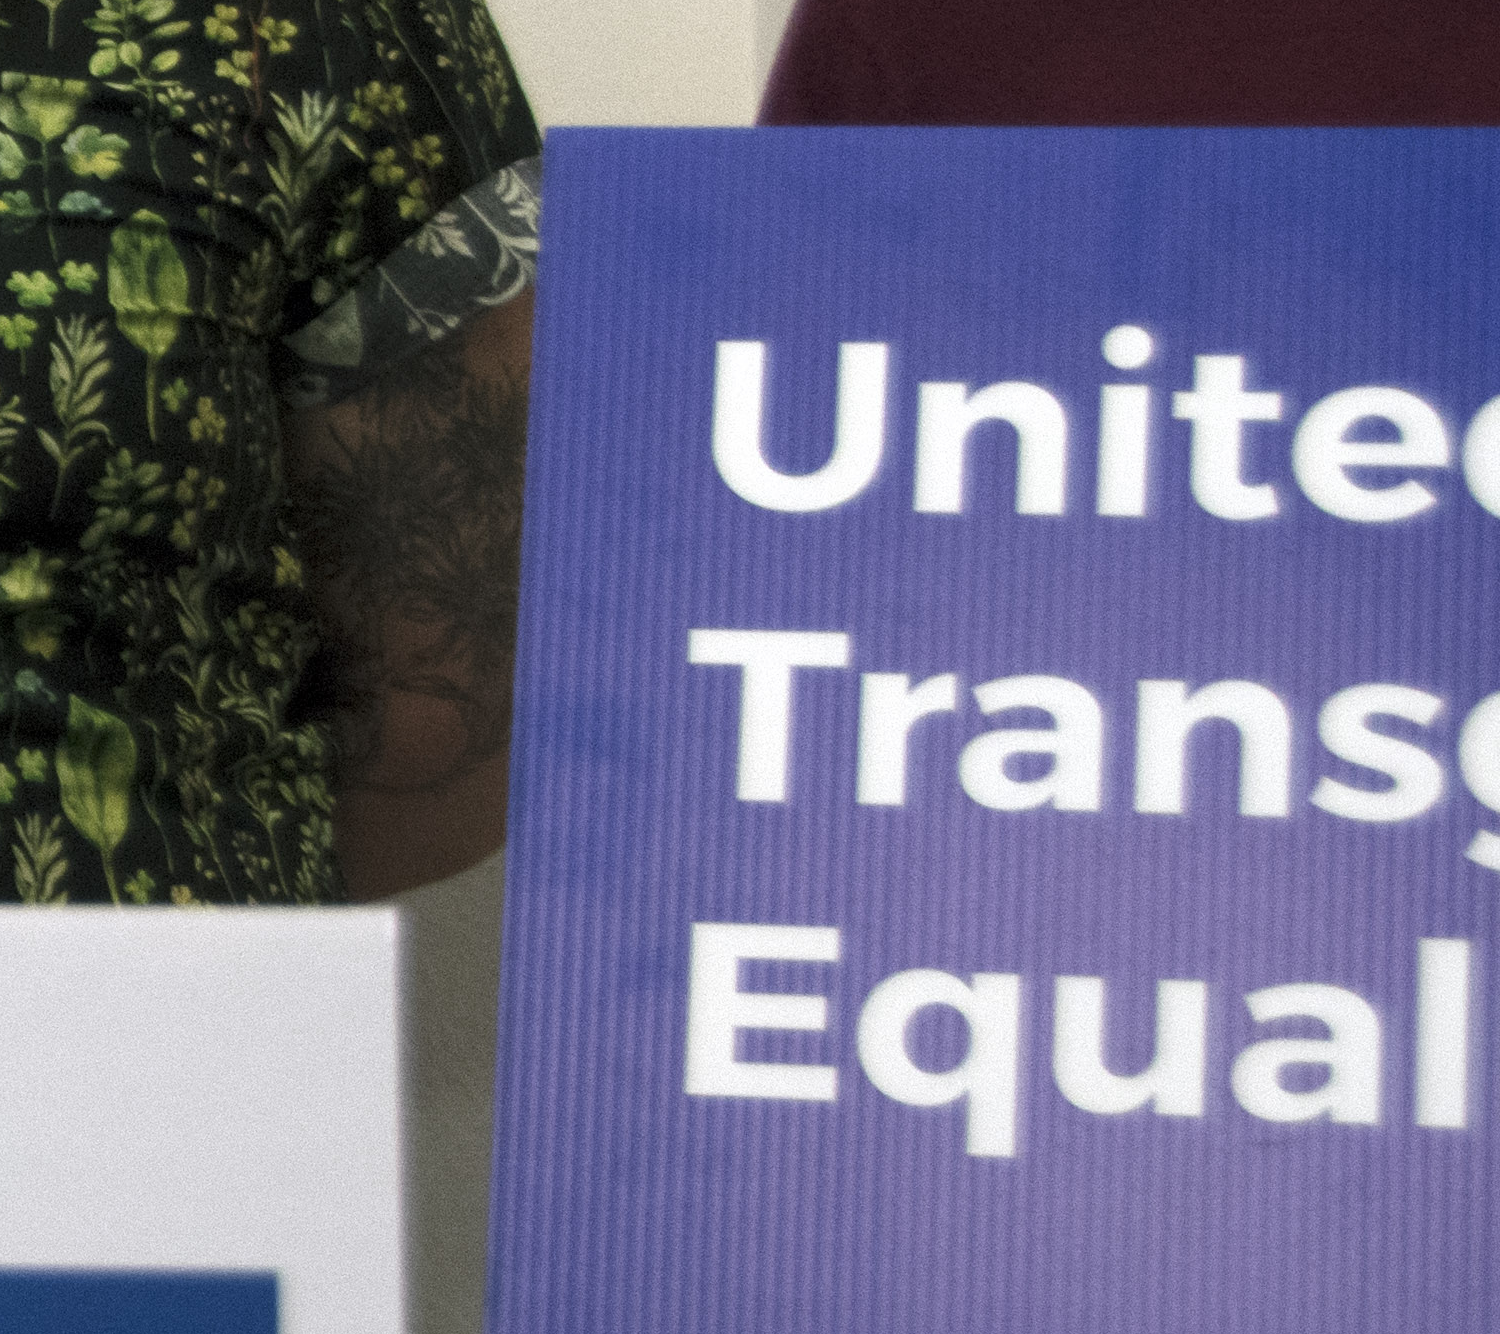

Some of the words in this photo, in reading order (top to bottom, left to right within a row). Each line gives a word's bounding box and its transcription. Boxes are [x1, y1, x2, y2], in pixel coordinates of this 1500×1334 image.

[711, 325, 1500, 523] Unite
[688, 628, 1500, 871] Trans
[684, 922, 1471, 1158] Equal
